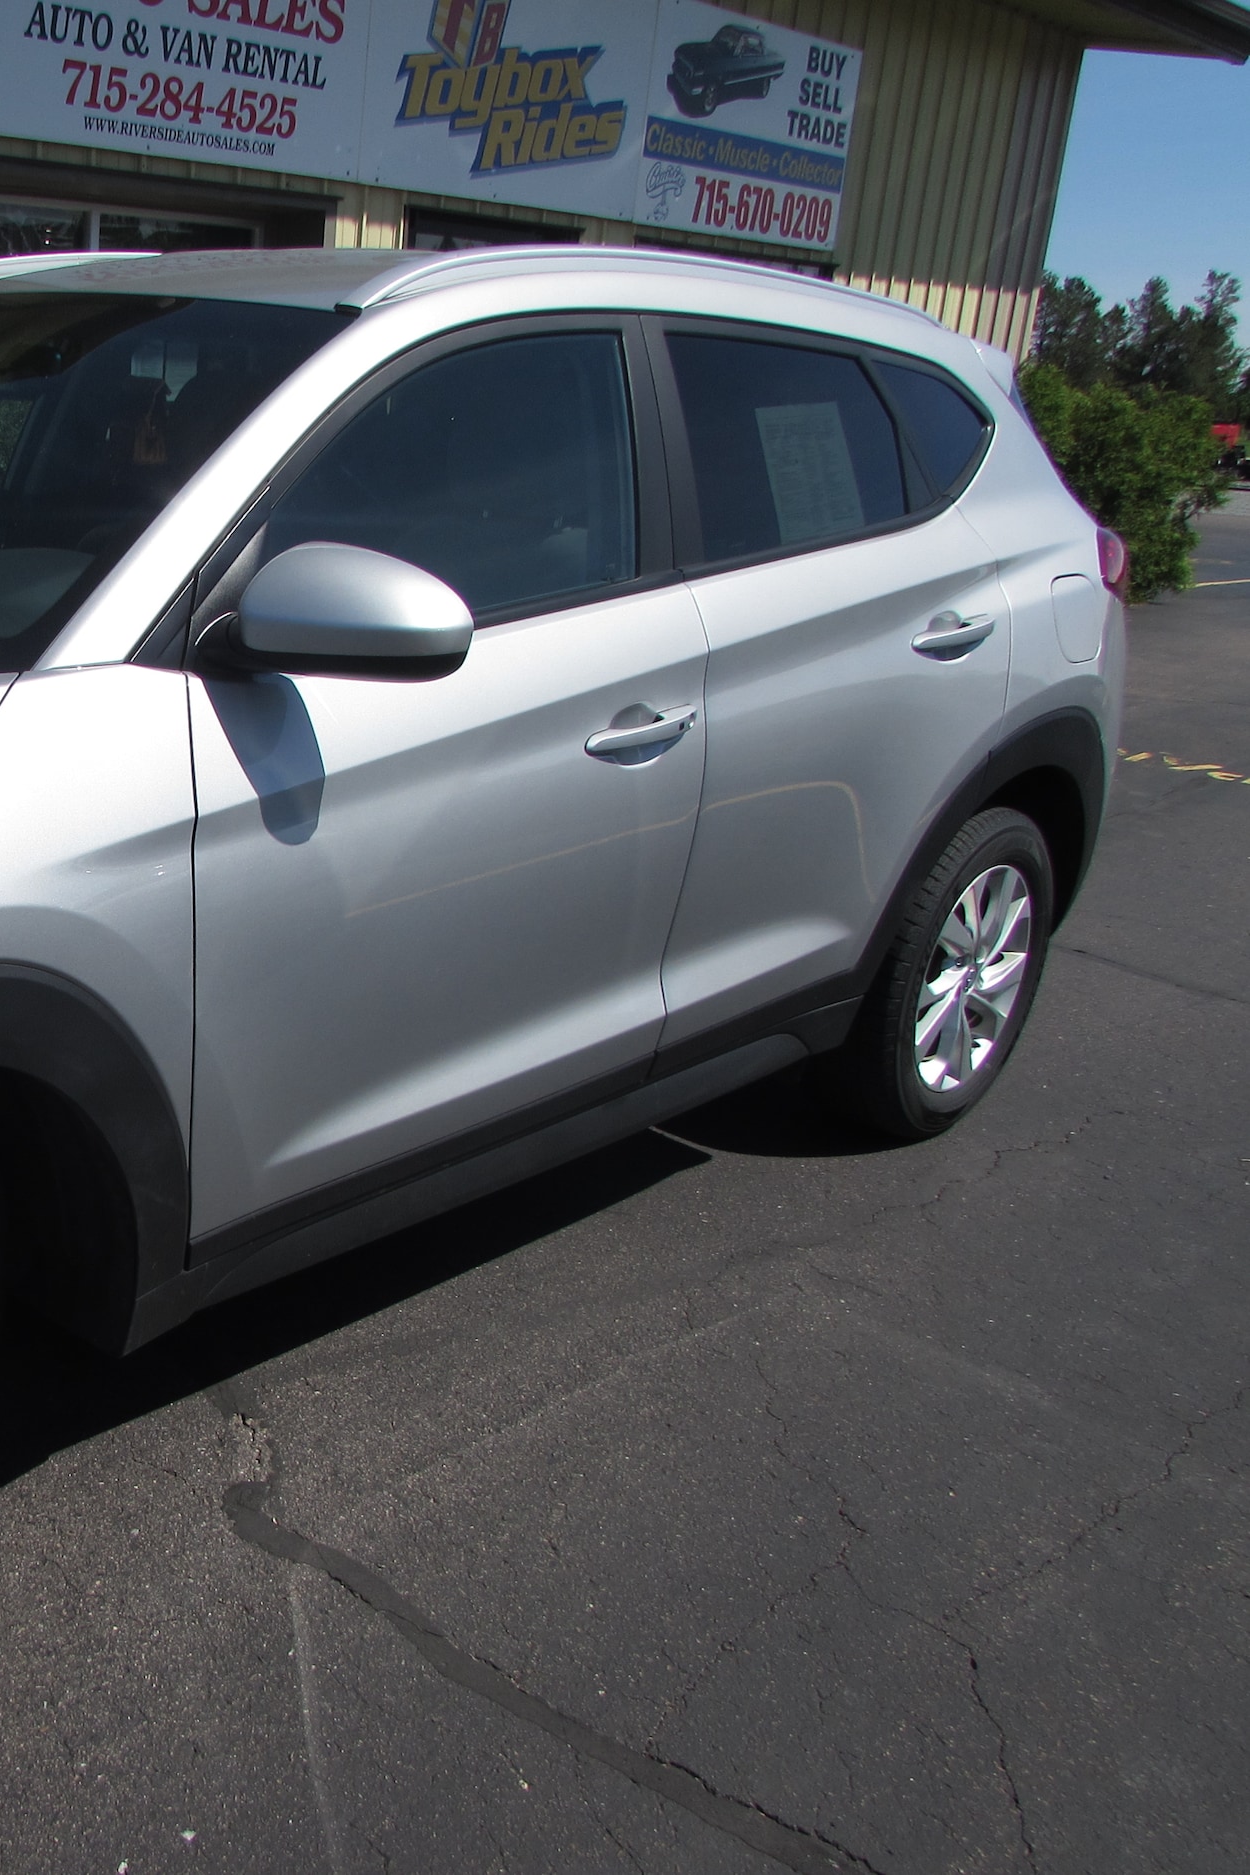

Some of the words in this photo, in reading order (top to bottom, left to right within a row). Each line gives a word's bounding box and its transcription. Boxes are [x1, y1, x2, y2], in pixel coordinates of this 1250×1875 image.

[23, 1, 114, 51] AUTO
[122, 18, 150, 59] &
[160, 24, 218, 71] VAN
[223, 37, 328, 90] RENTAL
[187, 0, 345, 43] ALES
[404, 49, 595, 129] Toybox
[807, 46, 847, 80] BUY
[61, 58, 298, 140] 715-284-4525
[799, 79, 842, 114] SELL
[83, 115, 276, 157] WWW.RIVERSIDEAUTOSALES.COM
[479, 103, 624, 170] Rides
[646, 123, 706, 160] Classic
[714, 138, 770, 173] Muscle
[779, 151, 843, 186] Collector
[787, 110, 847, 148] TRADE
[692, 176, 832, 243] 715-670-0209
